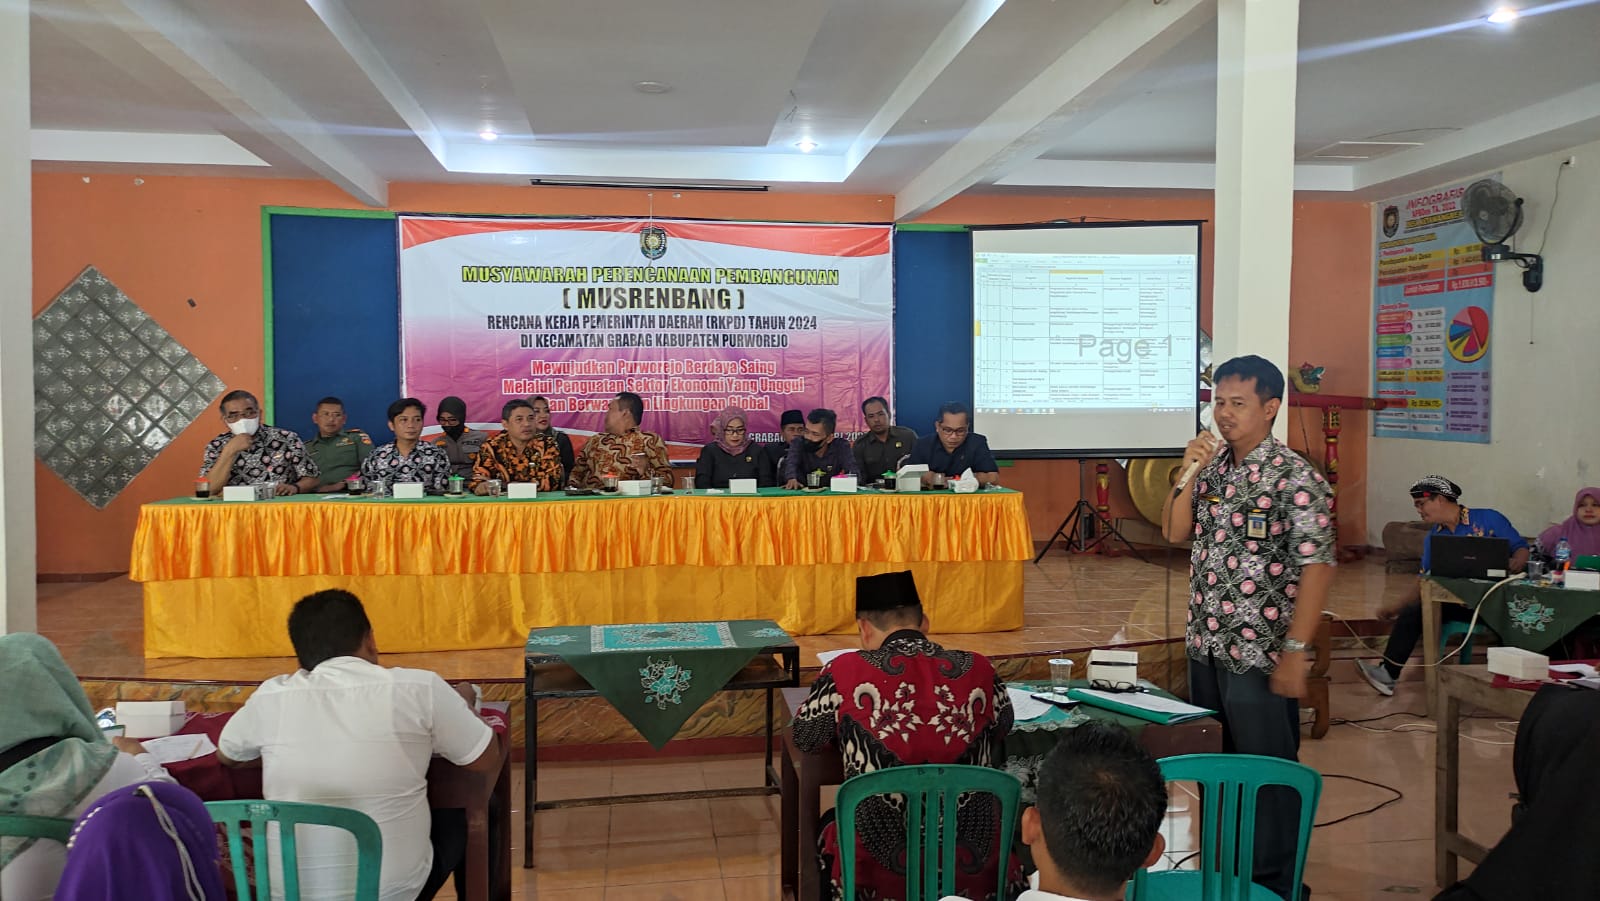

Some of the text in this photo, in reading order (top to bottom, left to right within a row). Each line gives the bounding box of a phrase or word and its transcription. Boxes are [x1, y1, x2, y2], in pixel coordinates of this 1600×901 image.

[462, 266, 839, 286] MUSYAWARAH PERENCANAAN PEMBANGUNAN
[577, 287, 731, 310] MUSRENBANG
[487, 315, 817, 330] RENCANA KERJA PEMERINTAH DAERAH (RKPD) TAHUN 2024
[520, 333, 788, 348] DI KECAMATAN GRABAG KABUPATEN PURWOREJO
[1079, 334, 1172, 363] Page 1
[531, 359, 776, 376] Mewujudkan Purworejo Berdaya Saing
[503, 377, 805, 395] Melalui Penguatan Sektor Ekonomi Yang Unggul
[548, 397, 567, 413] an
[652, 396, 726, 413] Lingkungan
[728, 395, 770, 411] Global
